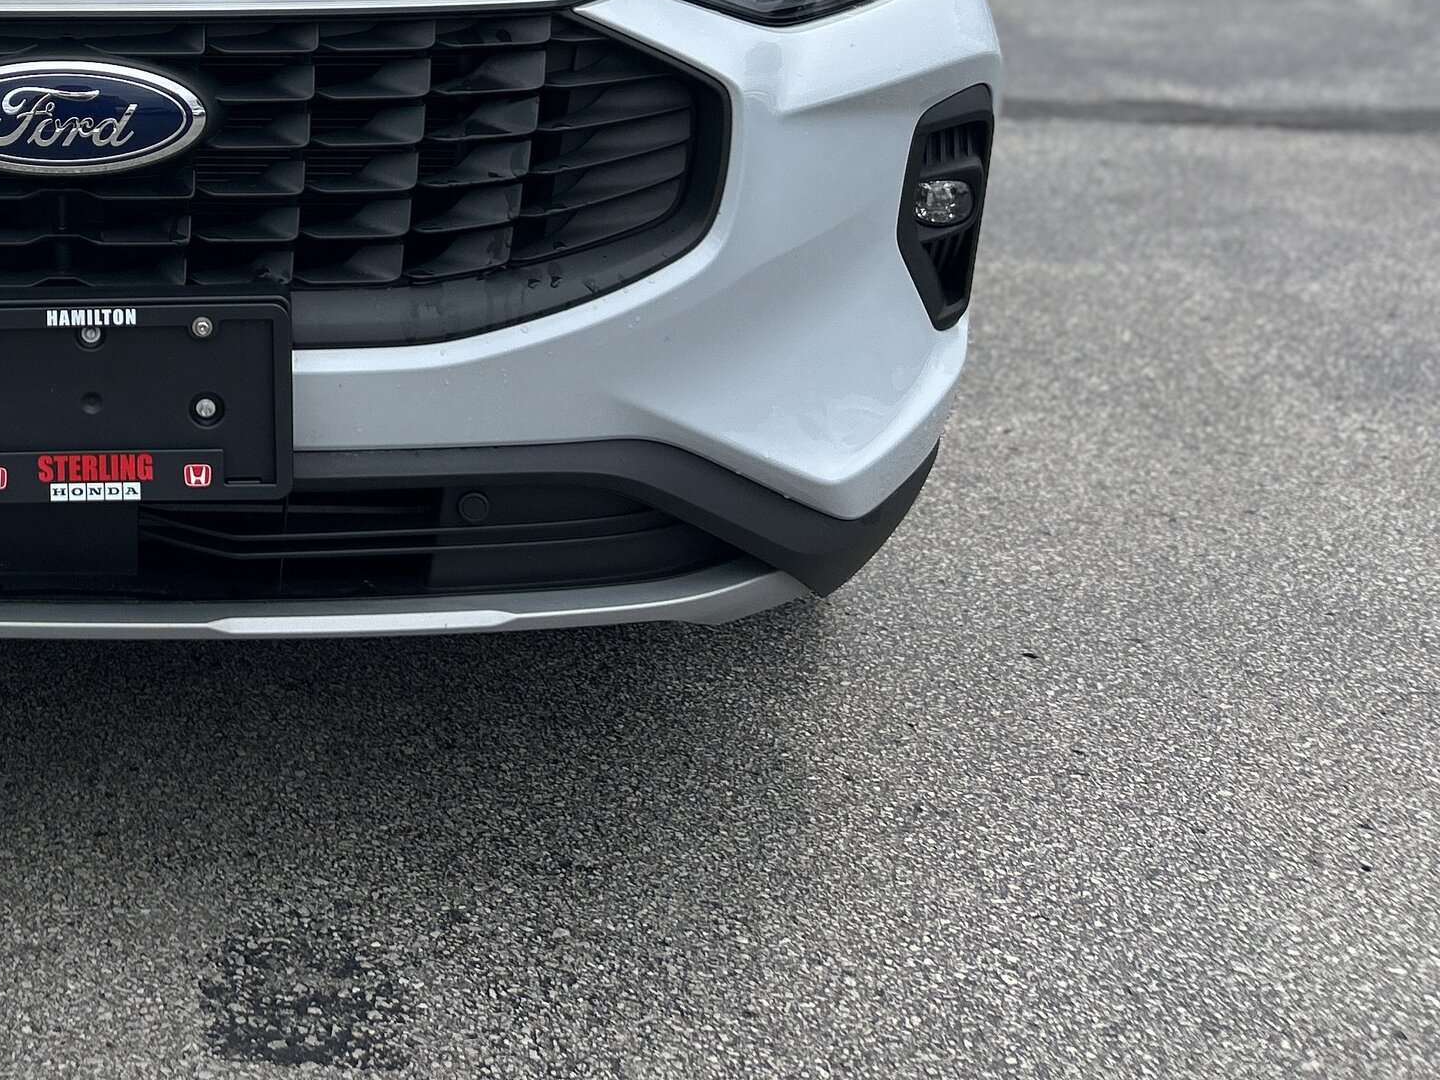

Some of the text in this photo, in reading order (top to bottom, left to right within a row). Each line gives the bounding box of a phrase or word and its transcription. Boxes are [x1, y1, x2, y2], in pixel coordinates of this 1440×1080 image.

[46, 307, 137, 327] HAMILTON
[37, 452, 154, 482] STERLING
[51, 485, 140, 499] HONDA
